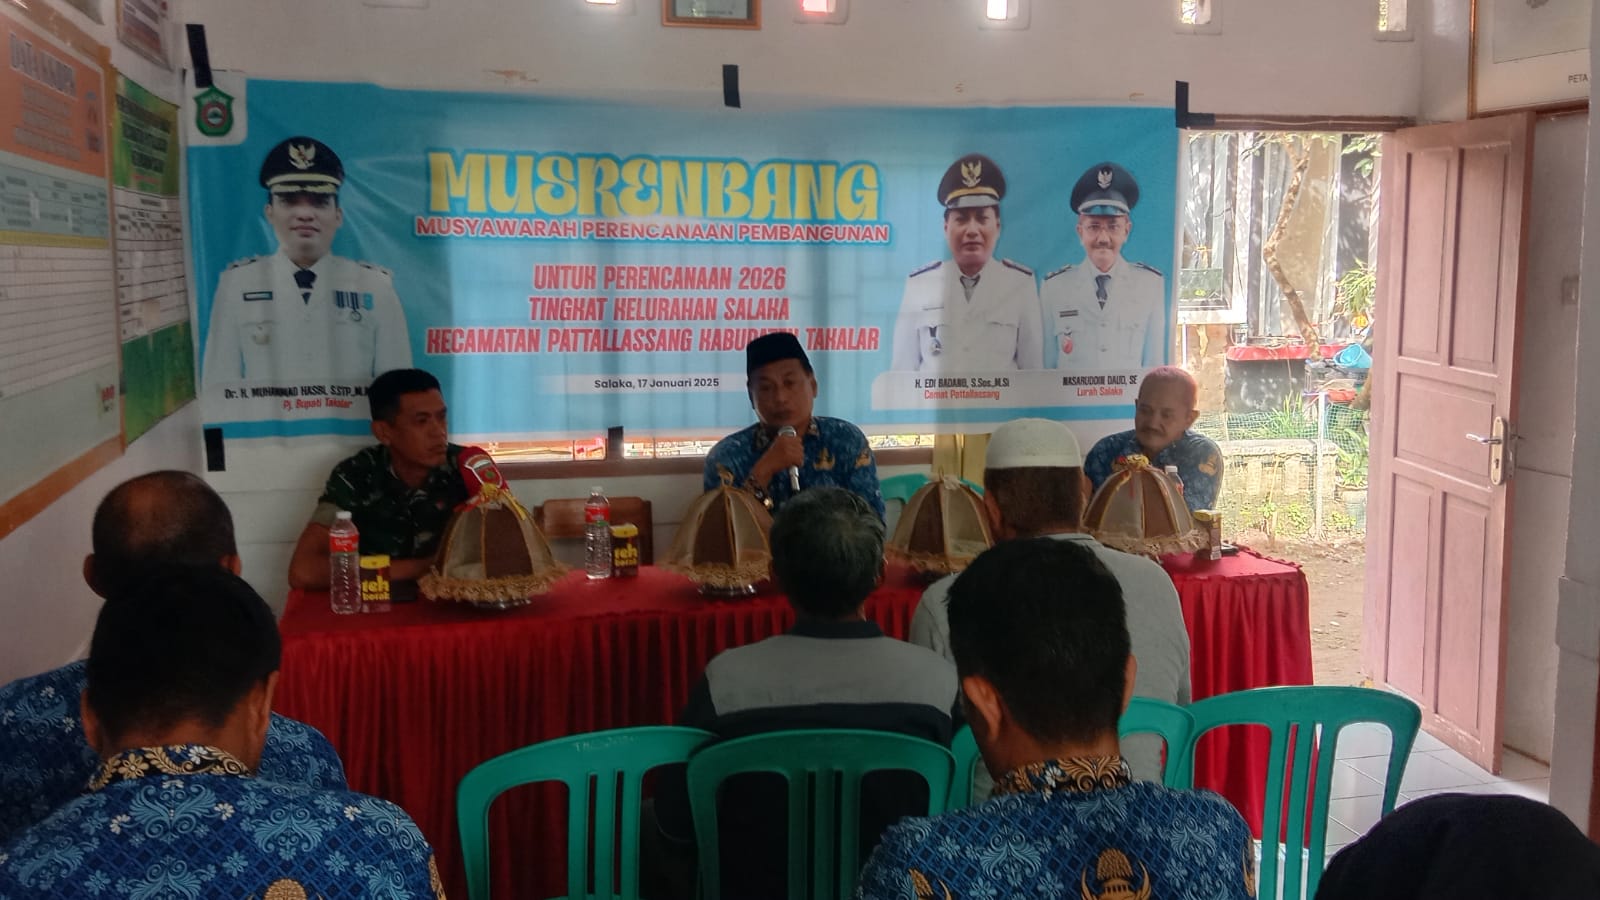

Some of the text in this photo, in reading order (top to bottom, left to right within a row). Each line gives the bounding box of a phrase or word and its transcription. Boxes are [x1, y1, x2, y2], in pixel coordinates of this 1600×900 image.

[1568, 74, 1589, 83] PETA
[428, 152, 879, 221] MUSRENBANG
[416, 218, 889, 242] MUSYAWARAH PERENCANAAN PEMBANGUNAN
[534, 265, 786, 290] UNTUK PERENCANAAN 2026
[529, 297, 790, 321] TINGKAT KELURAHAN SALAKA
[427, 328, 541, 353] KECAMATAN
[547, 328, 693, 352] PATTALLASSANG
[805, 327, 880, 351] TAKALAR
[594, 378, 720, 389] Salaka, 17 Januari 2025
[915, 379, 922, 389] H.
[924, 378, 937, 388] EDI
[1107, 375, 1128, 386] DAUD,
[1129, 375, 1139, 385] SE
[225, 388, 238, 399] Dr.
[924, 389, 948, 400] Camat
[1077, 386, 1123, 397] Lurah Salaka
[295, 398, 322, 409] Bupati
[614, 543, 638, 558] teh
[362, 575, 390, 593] teh
